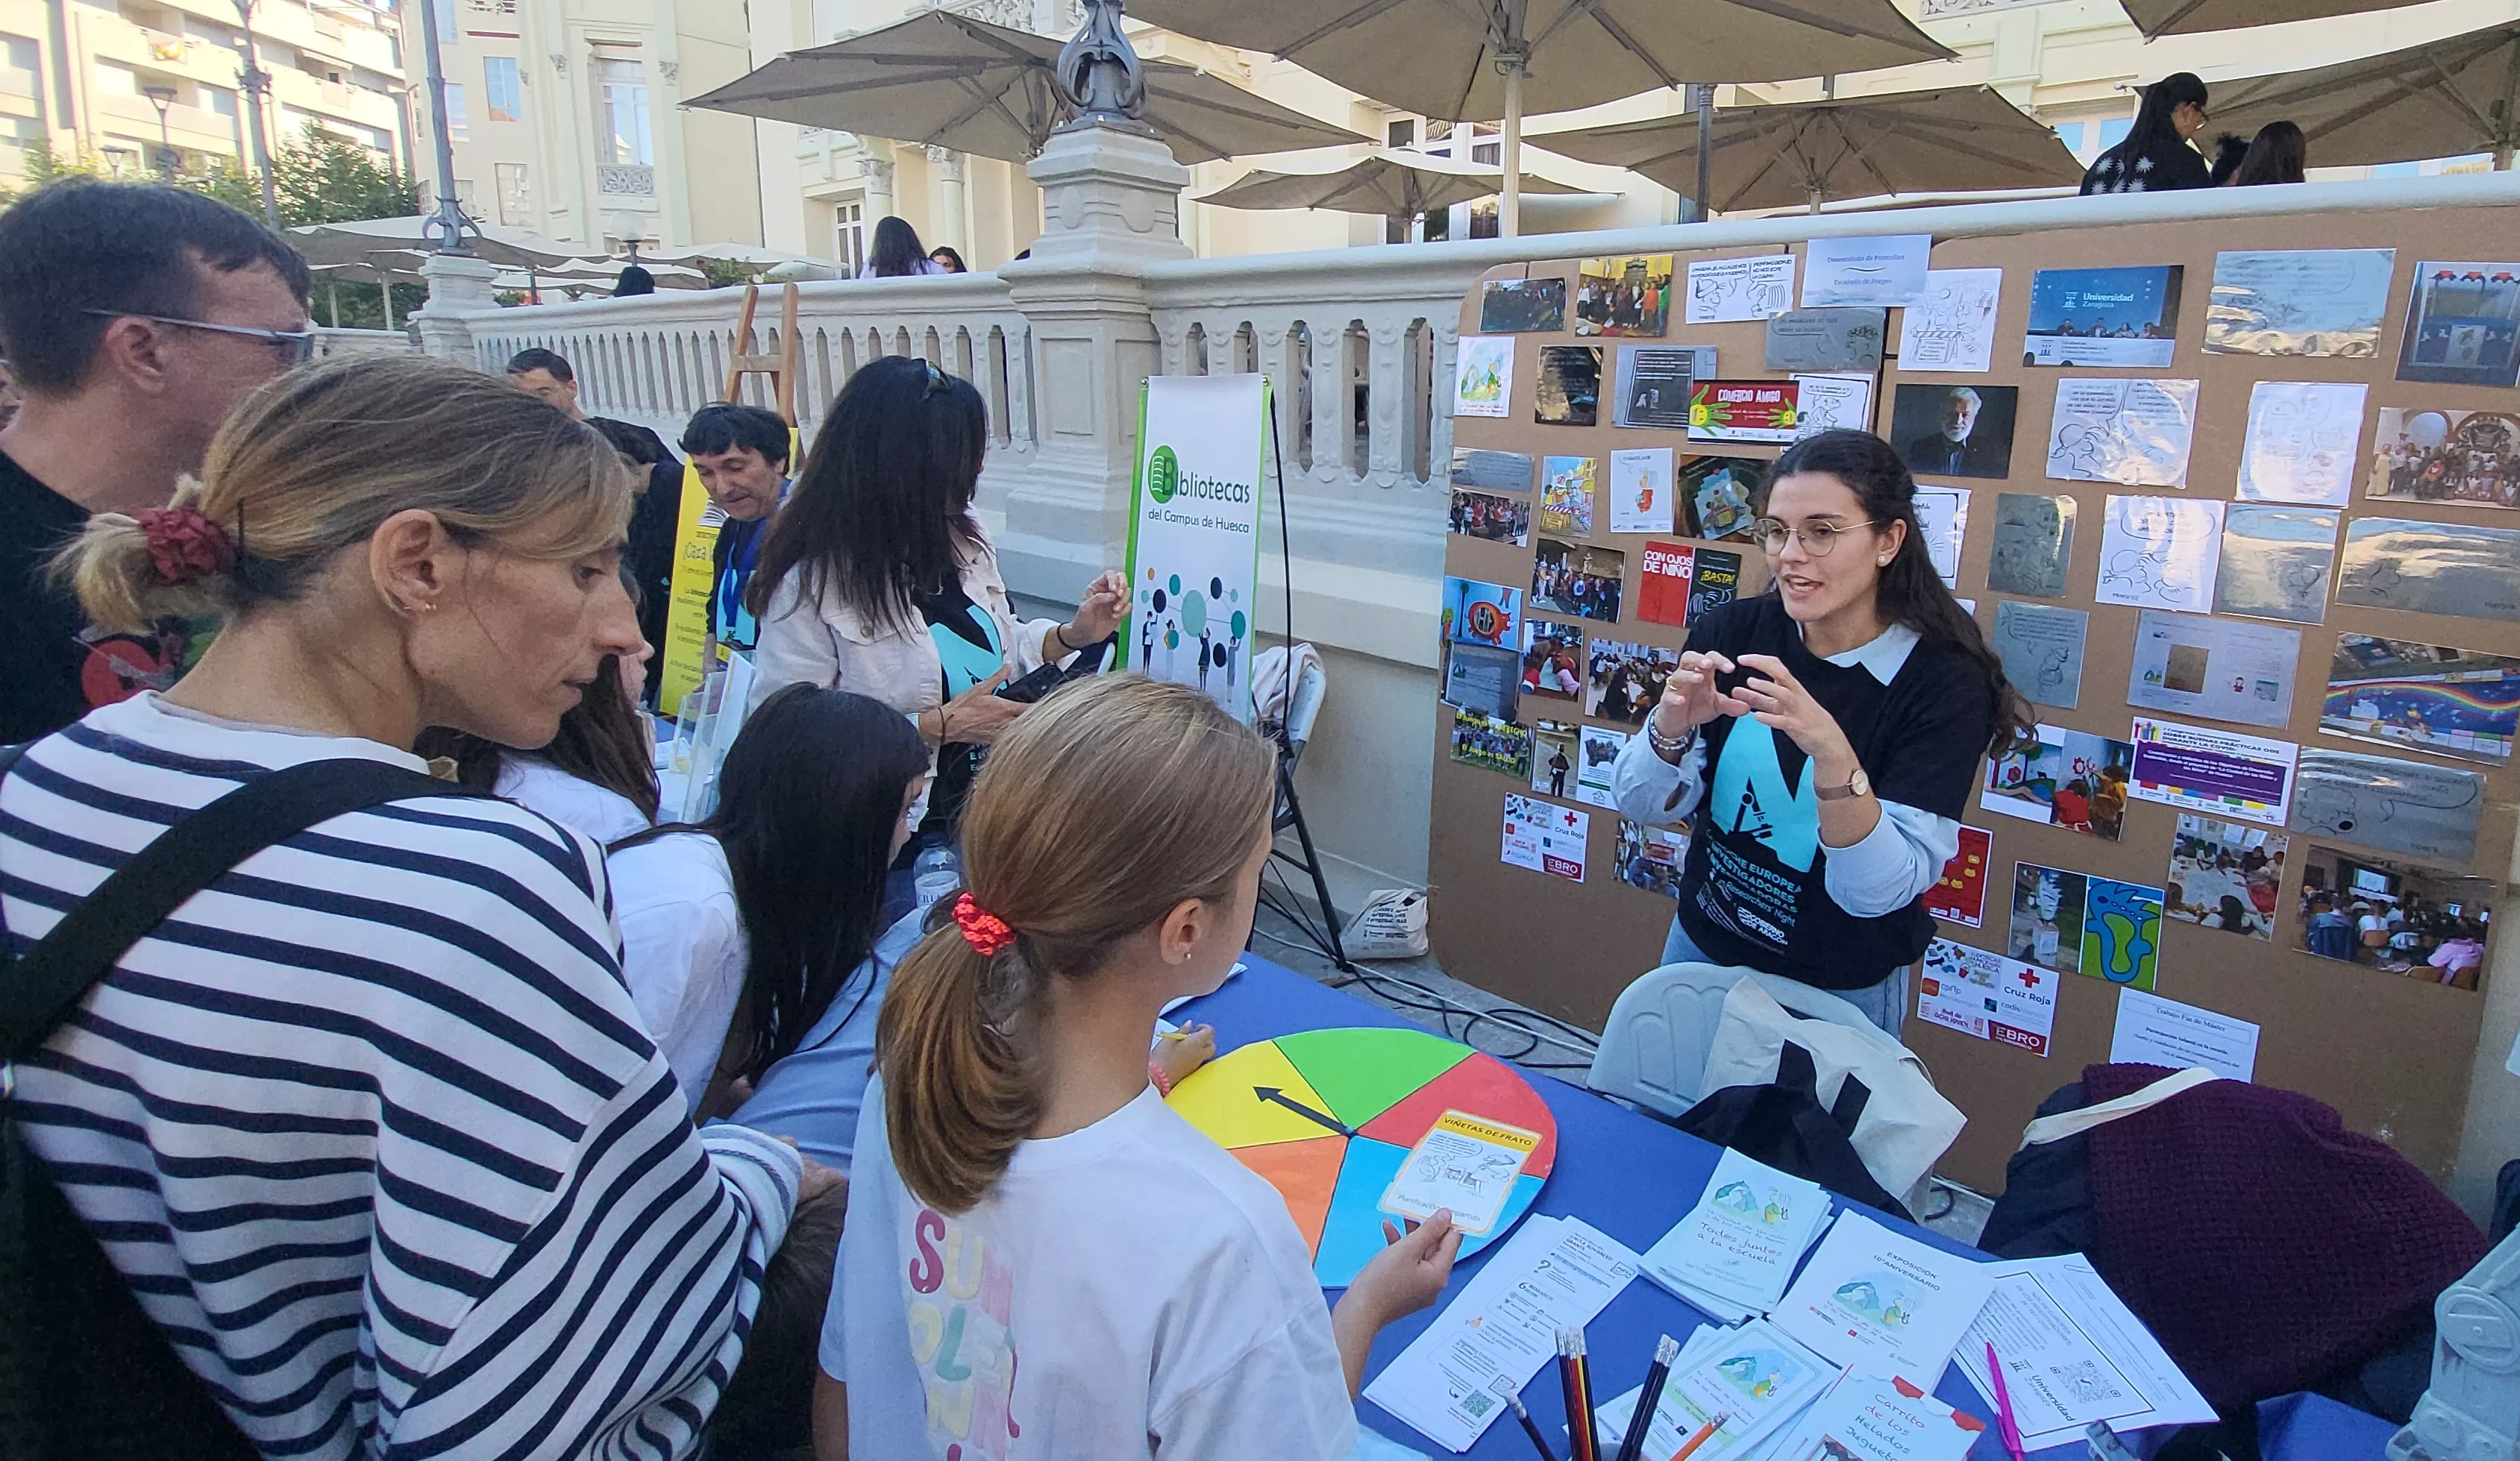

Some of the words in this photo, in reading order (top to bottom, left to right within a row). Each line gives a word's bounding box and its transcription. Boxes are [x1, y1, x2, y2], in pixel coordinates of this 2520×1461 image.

[2083, 292, 2134, 302] Universidad
[1718, 389, 1753, 403] COMERCIO
[1755, 390, 1781, 403] AMIGO
[1149, 509, 1162, 521] del
[1165, 510, 1199, 526] Campus
[1202, 515, 1213, 528] de
[1216, 517, 1249, 533] Huesca
[1643, 560, 1661, 574] DE
[1645, 550, 1666, 562] CON
[1667, 554, 1693, 566] OJOS
[2163, 736, 2197, 745] DURANTE
[2188, 735, 2218, 744] BUENAS
[2219, 740, 2261, 751] PRÁCTICAS
[1555, 827, 1569, 835] Cruz
[1570, 831, 1584, 840] Roja
[1548, 858, 1578, 874] EBRO
[1711, 842, 1795, 904] INVESTIGADORES
[1749, 863, 1802, 893] EUROPEA
[1750, 914, 1785, 938] GOBIERNO
[1775, 908, 1796, 927] Night
[2005, 986, 2026, 999] Cruz
[2029, 993, 2051, 1005] Roja
[2182, 1014, 2193, 1022] Fin
[1996, 1025, 2040, 1047] EBRO
[1444, 1117, 1483, 1133] VIÑETAS
[1485, 1128, 1497, 1137] DE
[1499, 1133, 1532, 1146] FRATO
[1398, 1194, 1441, 1210] Planificación
[1710, 1237, 1723, 1248] la
[1728, 1246, 1776, 1266] escuela
[2031, 1374, 2076, 1422] Universidad
[1865, 1406, 1883, 1420] de
[1875, 1394, 1925, 1428] Carrito
[1855, 1415, 1910, 1454] Helados
